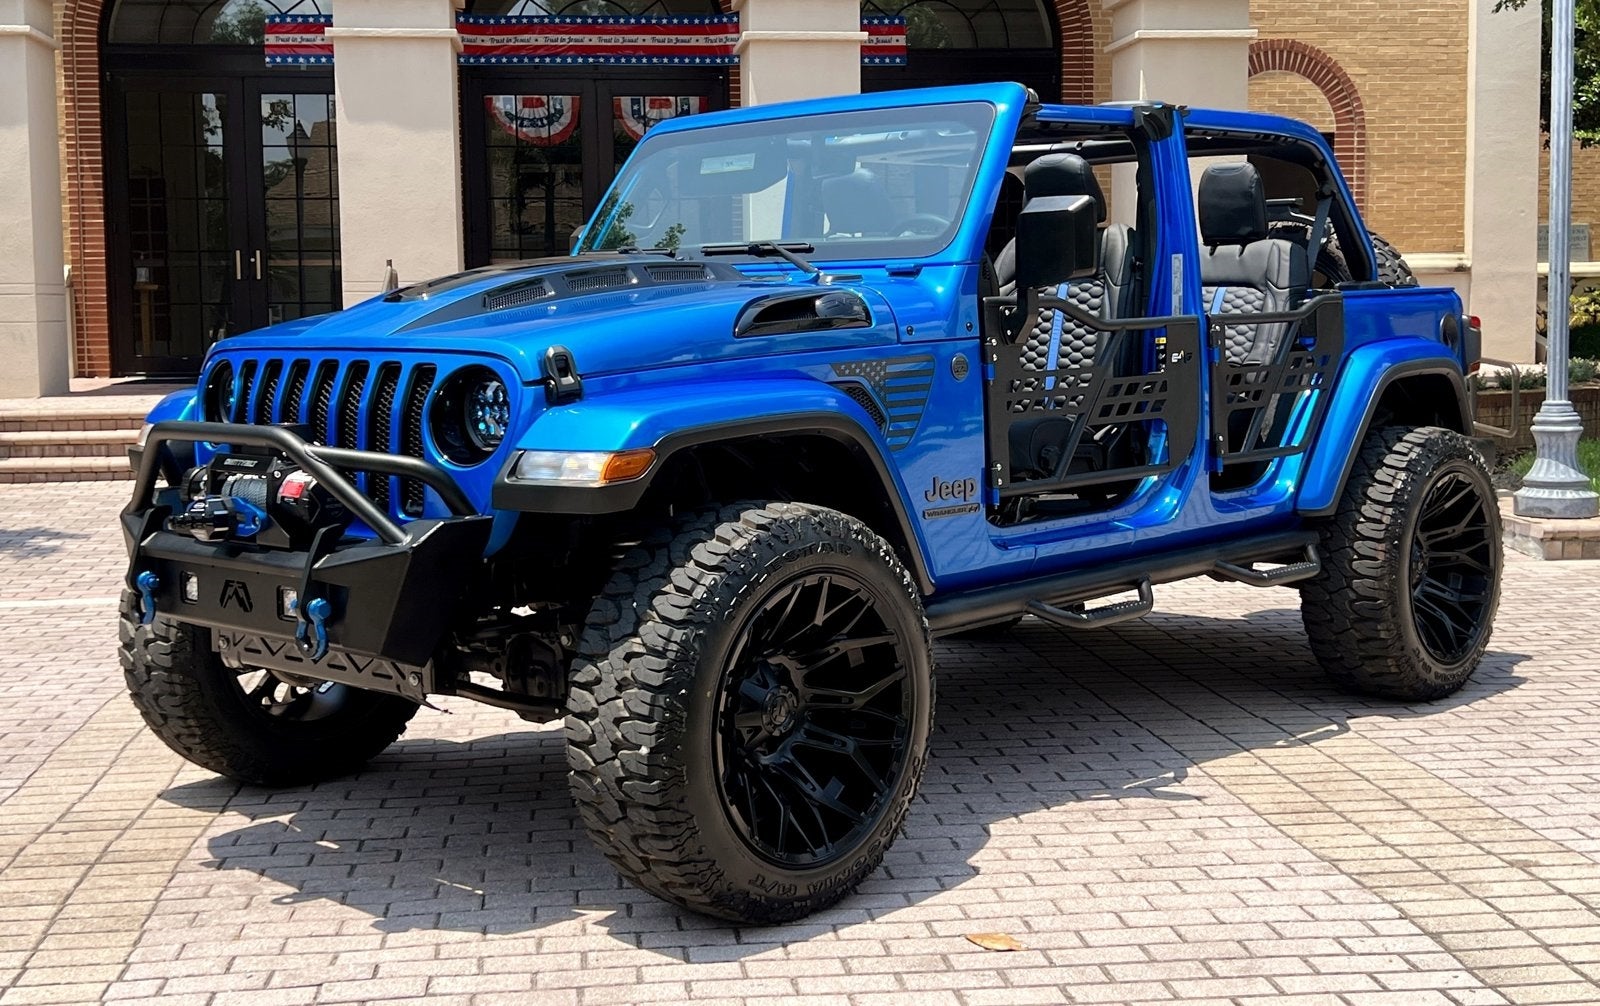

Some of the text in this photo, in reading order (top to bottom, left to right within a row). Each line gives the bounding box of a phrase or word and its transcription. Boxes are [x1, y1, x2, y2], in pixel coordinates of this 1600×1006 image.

[275, 35, 291, 43] Trust
[298, 35, 318, 44] Jesus!
[513, 36, 532, 44] Jesus!
[566, 36, 585, 44] Jesus!
[620, 36, 639, 44] Jesus!
[673, 36, 692, 44] Jesus!
[874, 36, 893, 45] Jesus!
[924, 475, 977, 502] Jeep
[748, 873, 798, 897] M/T
